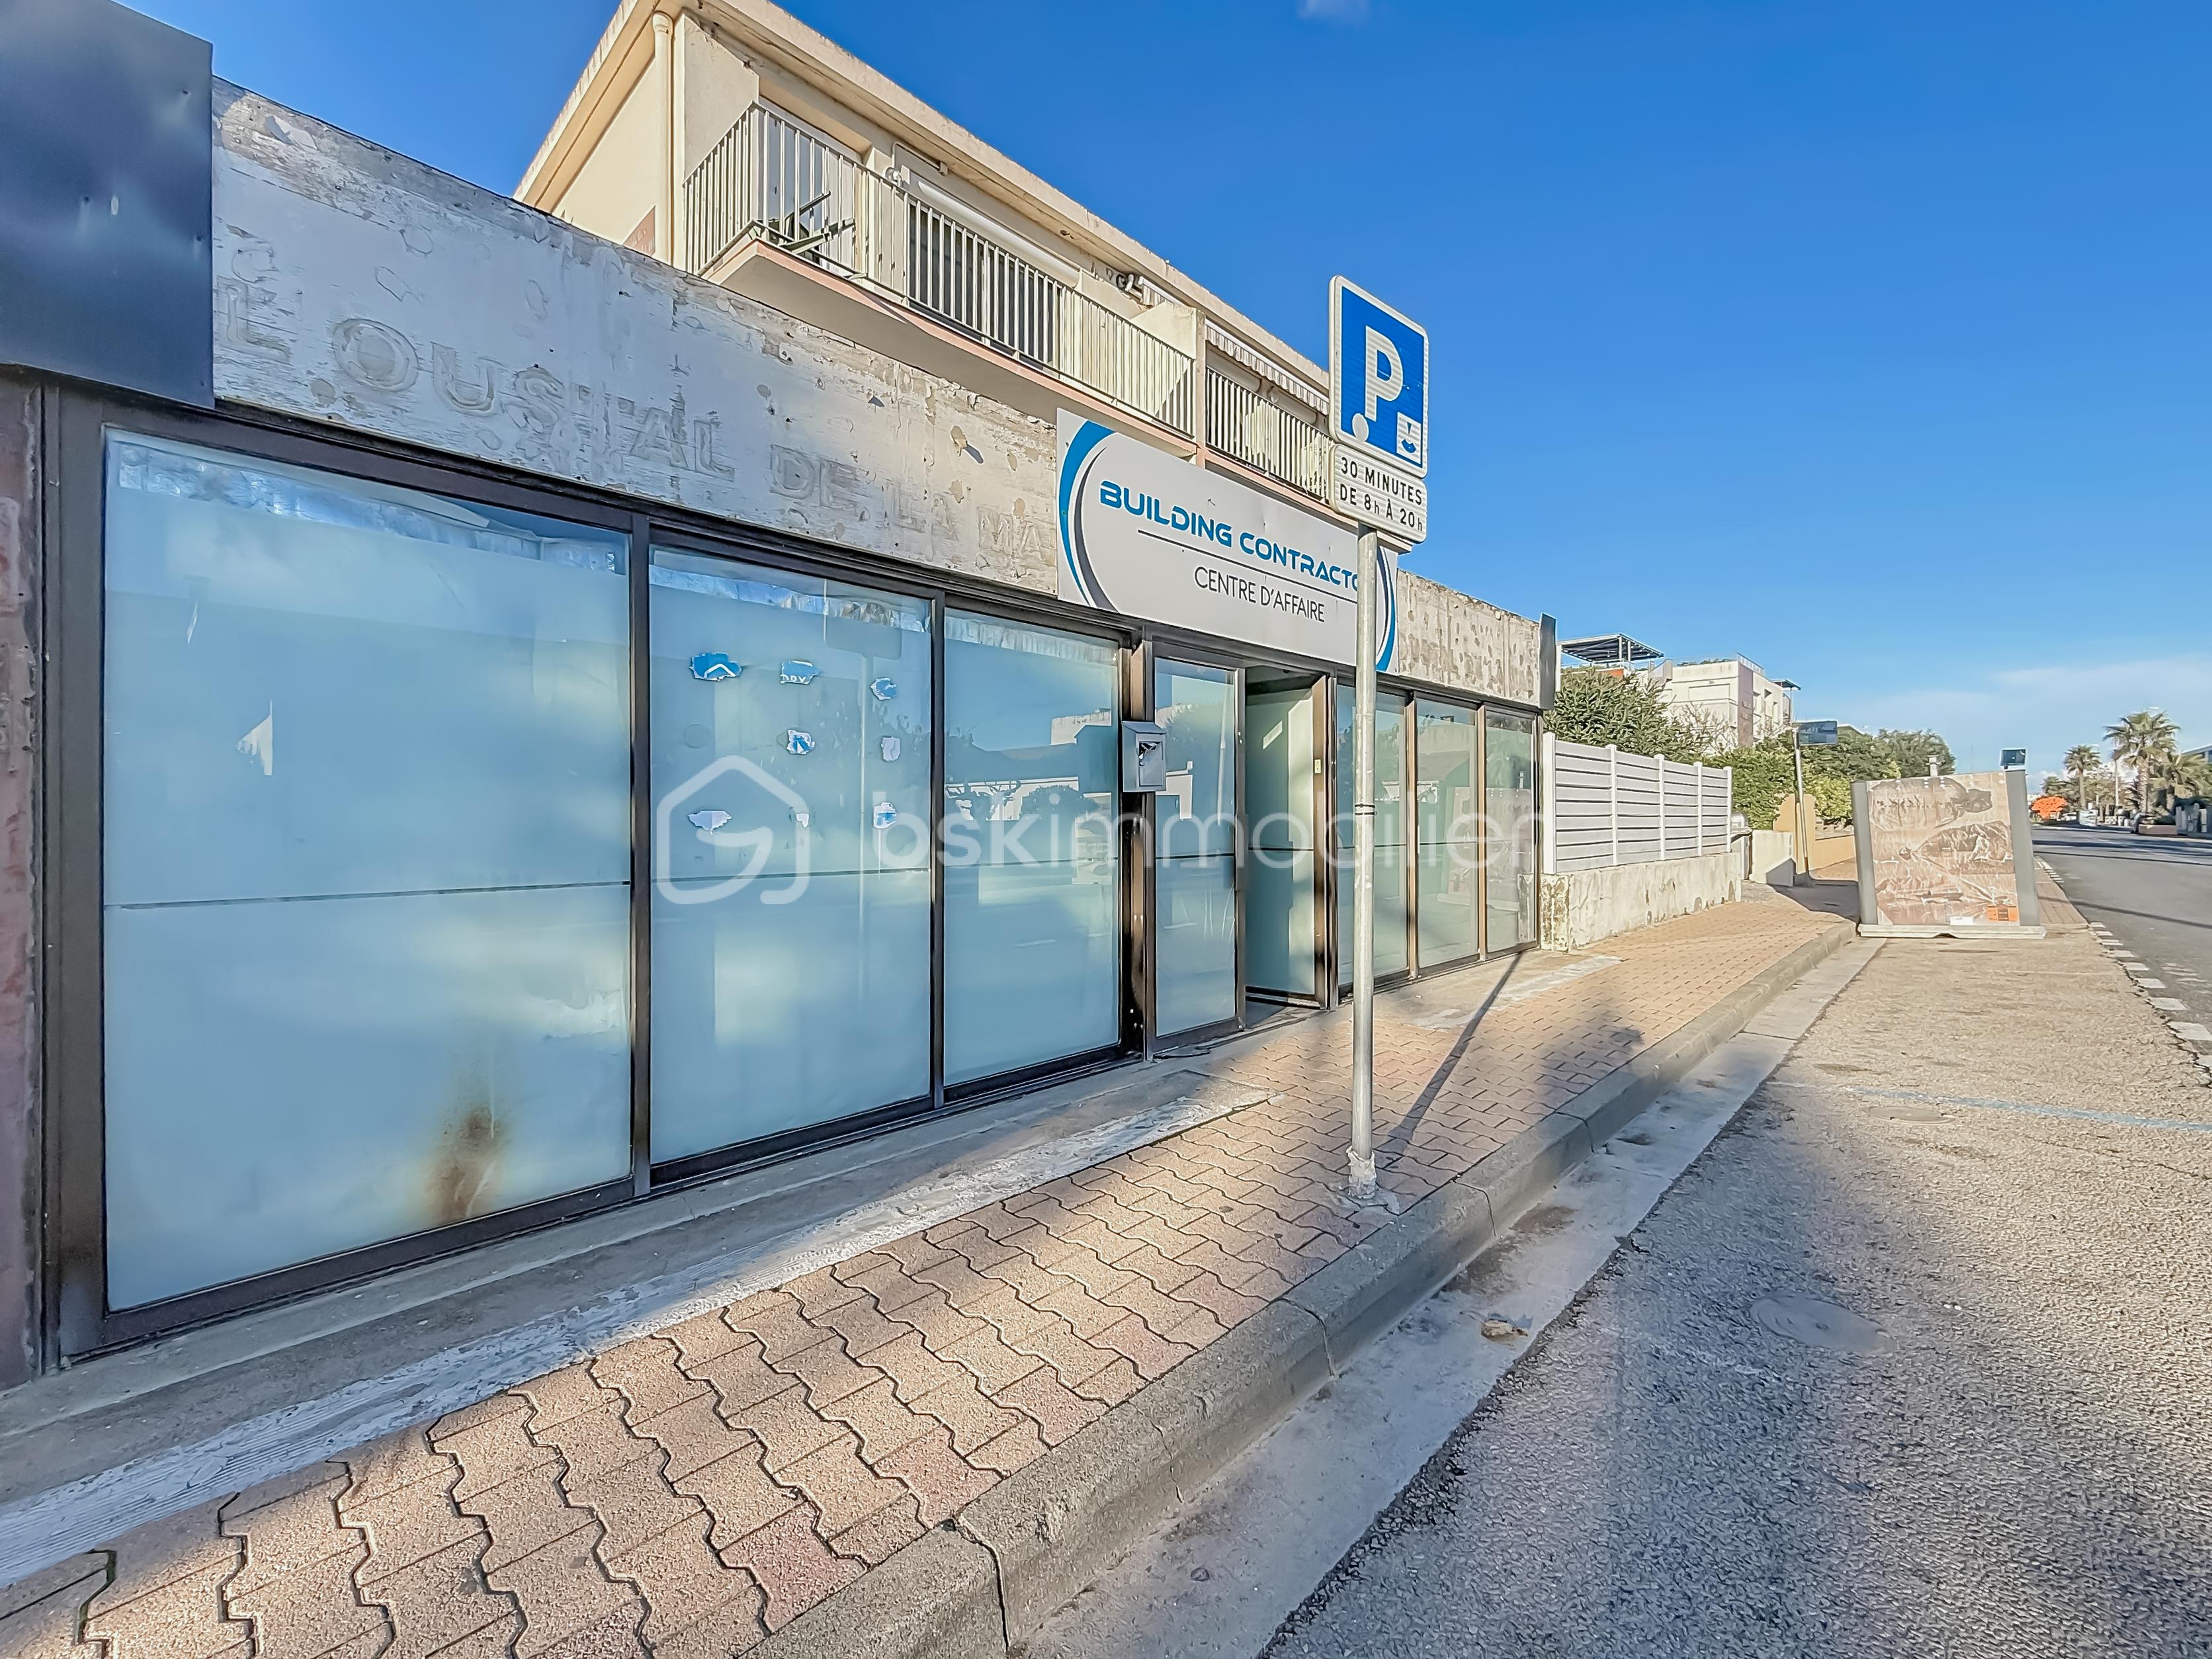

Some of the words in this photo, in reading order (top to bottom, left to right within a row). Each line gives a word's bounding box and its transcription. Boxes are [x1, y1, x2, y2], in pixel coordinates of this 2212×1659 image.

[1365, 325, 1404, 422] P
[1340, 483, 1357, 506] DE
[1364, 493, 1380, 515] 8h
[1386, 498, 1394, 521] À
[1400, 508, 1423, 532] 20h
[1341, 456, 1358, 478] 30
[1365, 466, 1422, 505] MINUTES
[1099, 480, 1232, 548] BUILDING
[1239, 532, 1358, 592] CONTRACT
[1194, 566, 1257, 603] CENTRE
[1260, 585, 1325, 622] D'AFFAIRE
